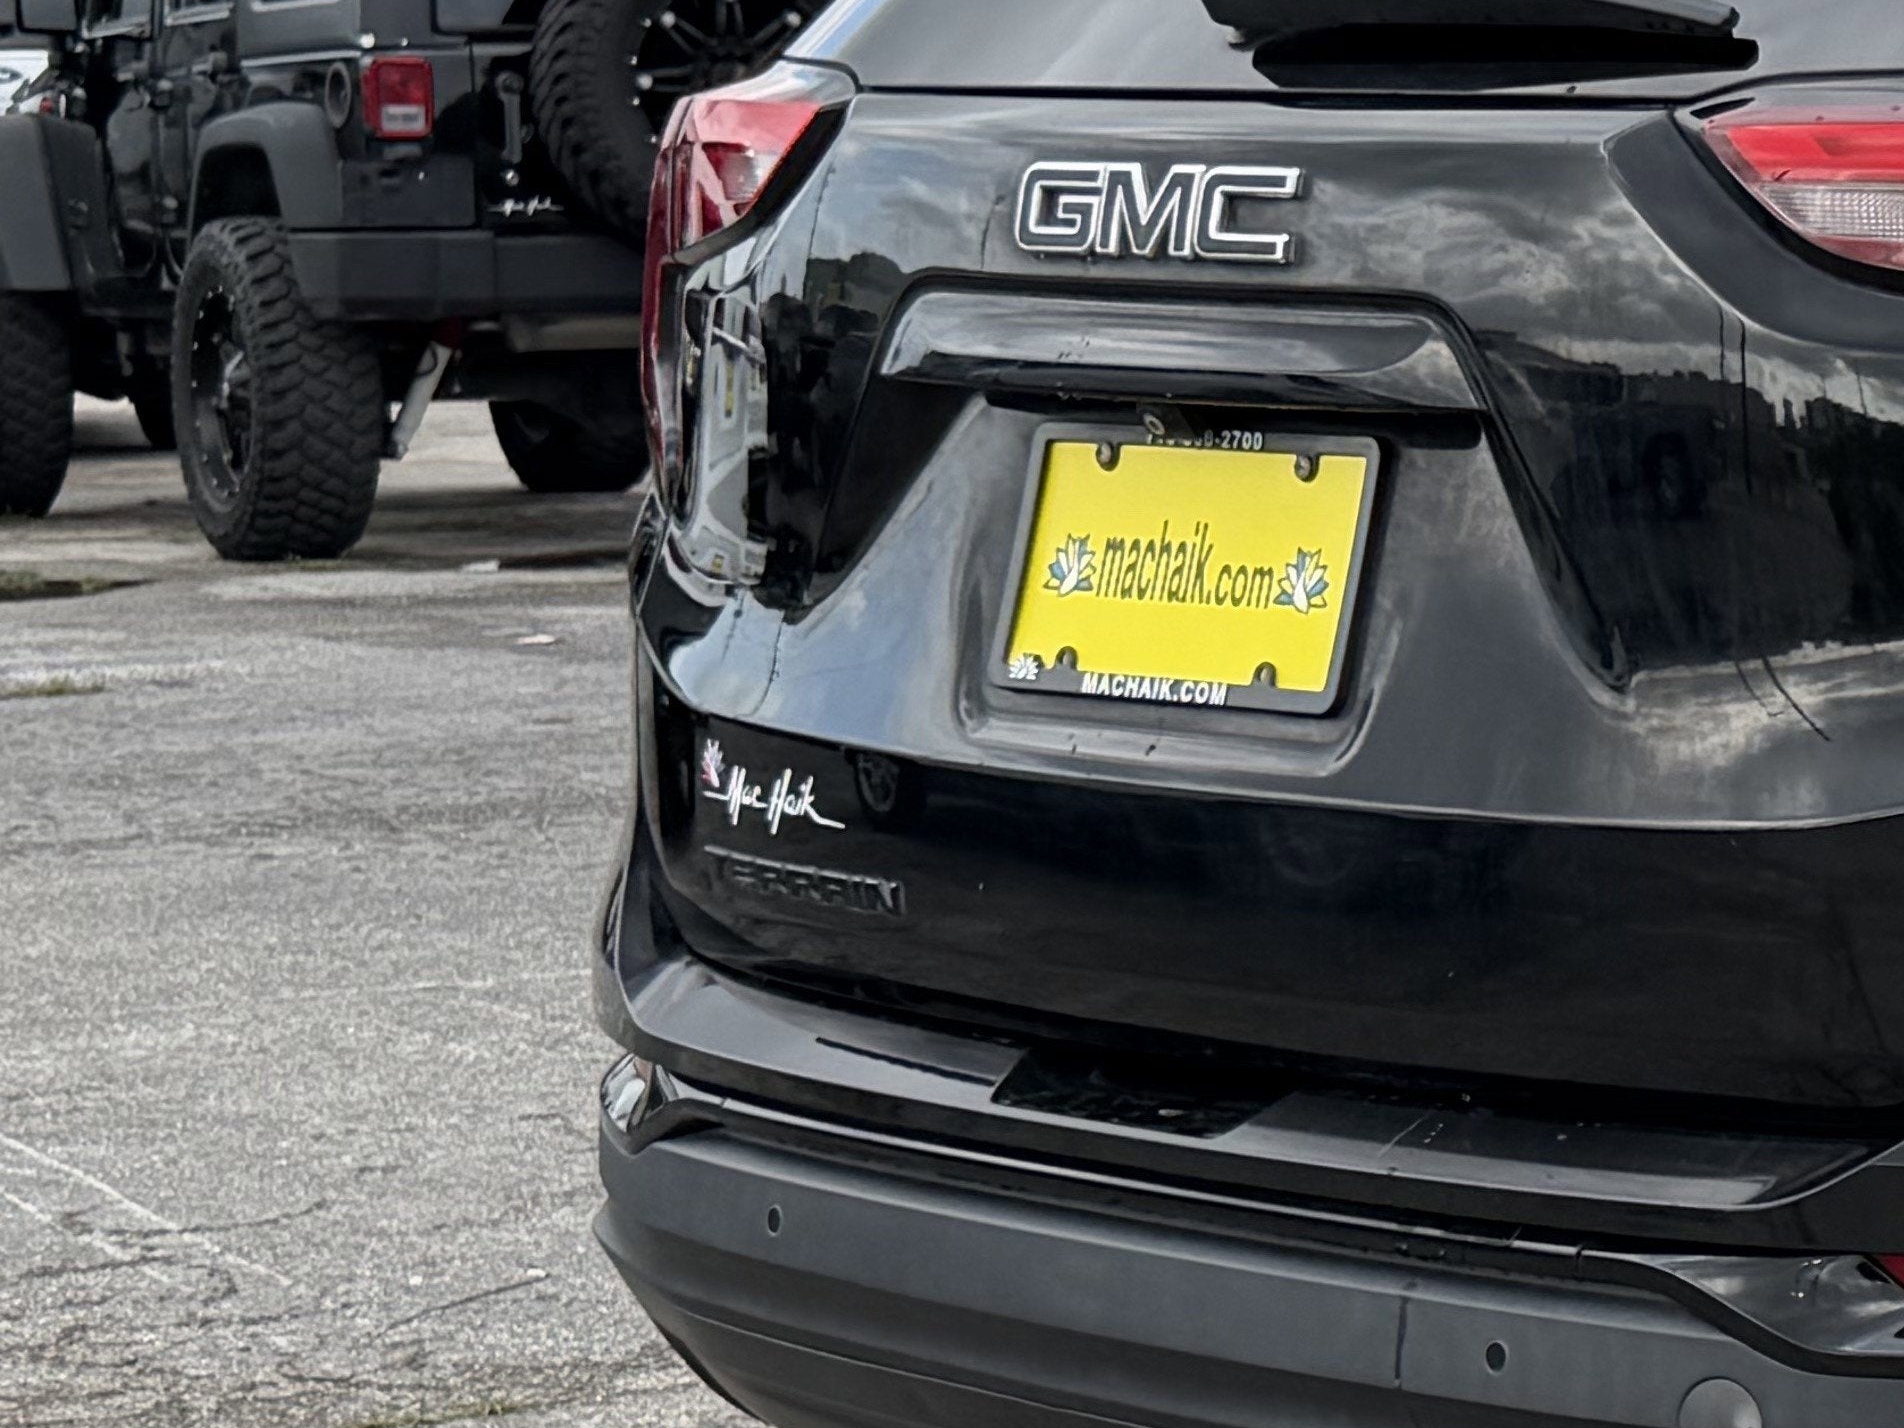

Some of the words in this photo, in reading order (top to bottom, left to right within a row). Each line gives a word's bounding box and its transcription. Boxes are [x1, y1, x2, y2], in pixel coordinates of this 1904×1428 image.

[1014, 161, 1303, 263] GMC
[1096, 520, 1275, 611] machaik.com
[1081, 673, 1228, 706] MACHAIK.COM
